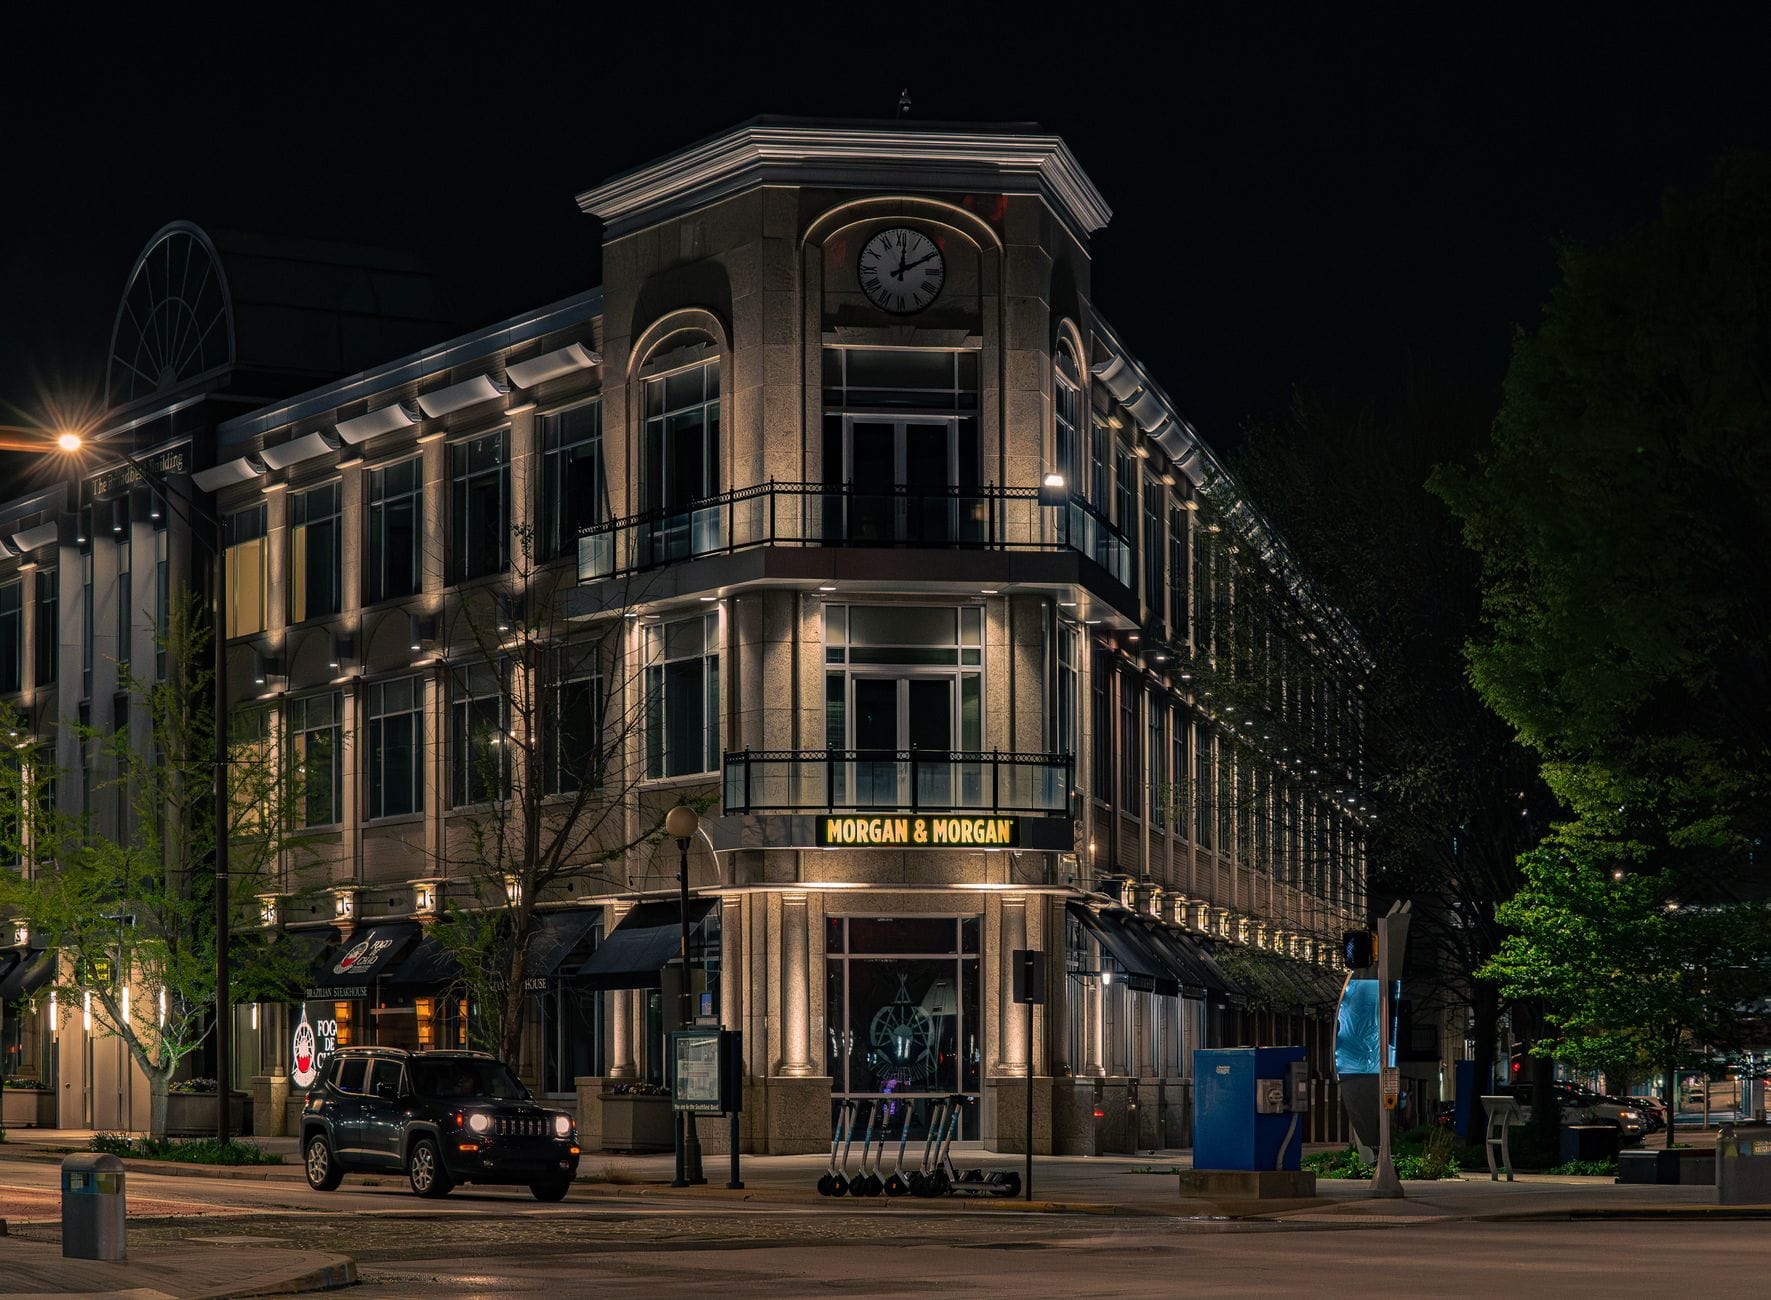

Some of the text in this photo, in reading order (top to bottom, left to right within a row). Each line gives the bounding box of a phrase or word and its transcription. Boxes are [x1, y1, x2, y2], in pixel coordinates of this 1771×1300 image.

[827, 818, 1010, 843] MORGAN & MORGAN
[317, 1019, 337, 1037] FOG
[324, 1037, 335, 1051] DE
